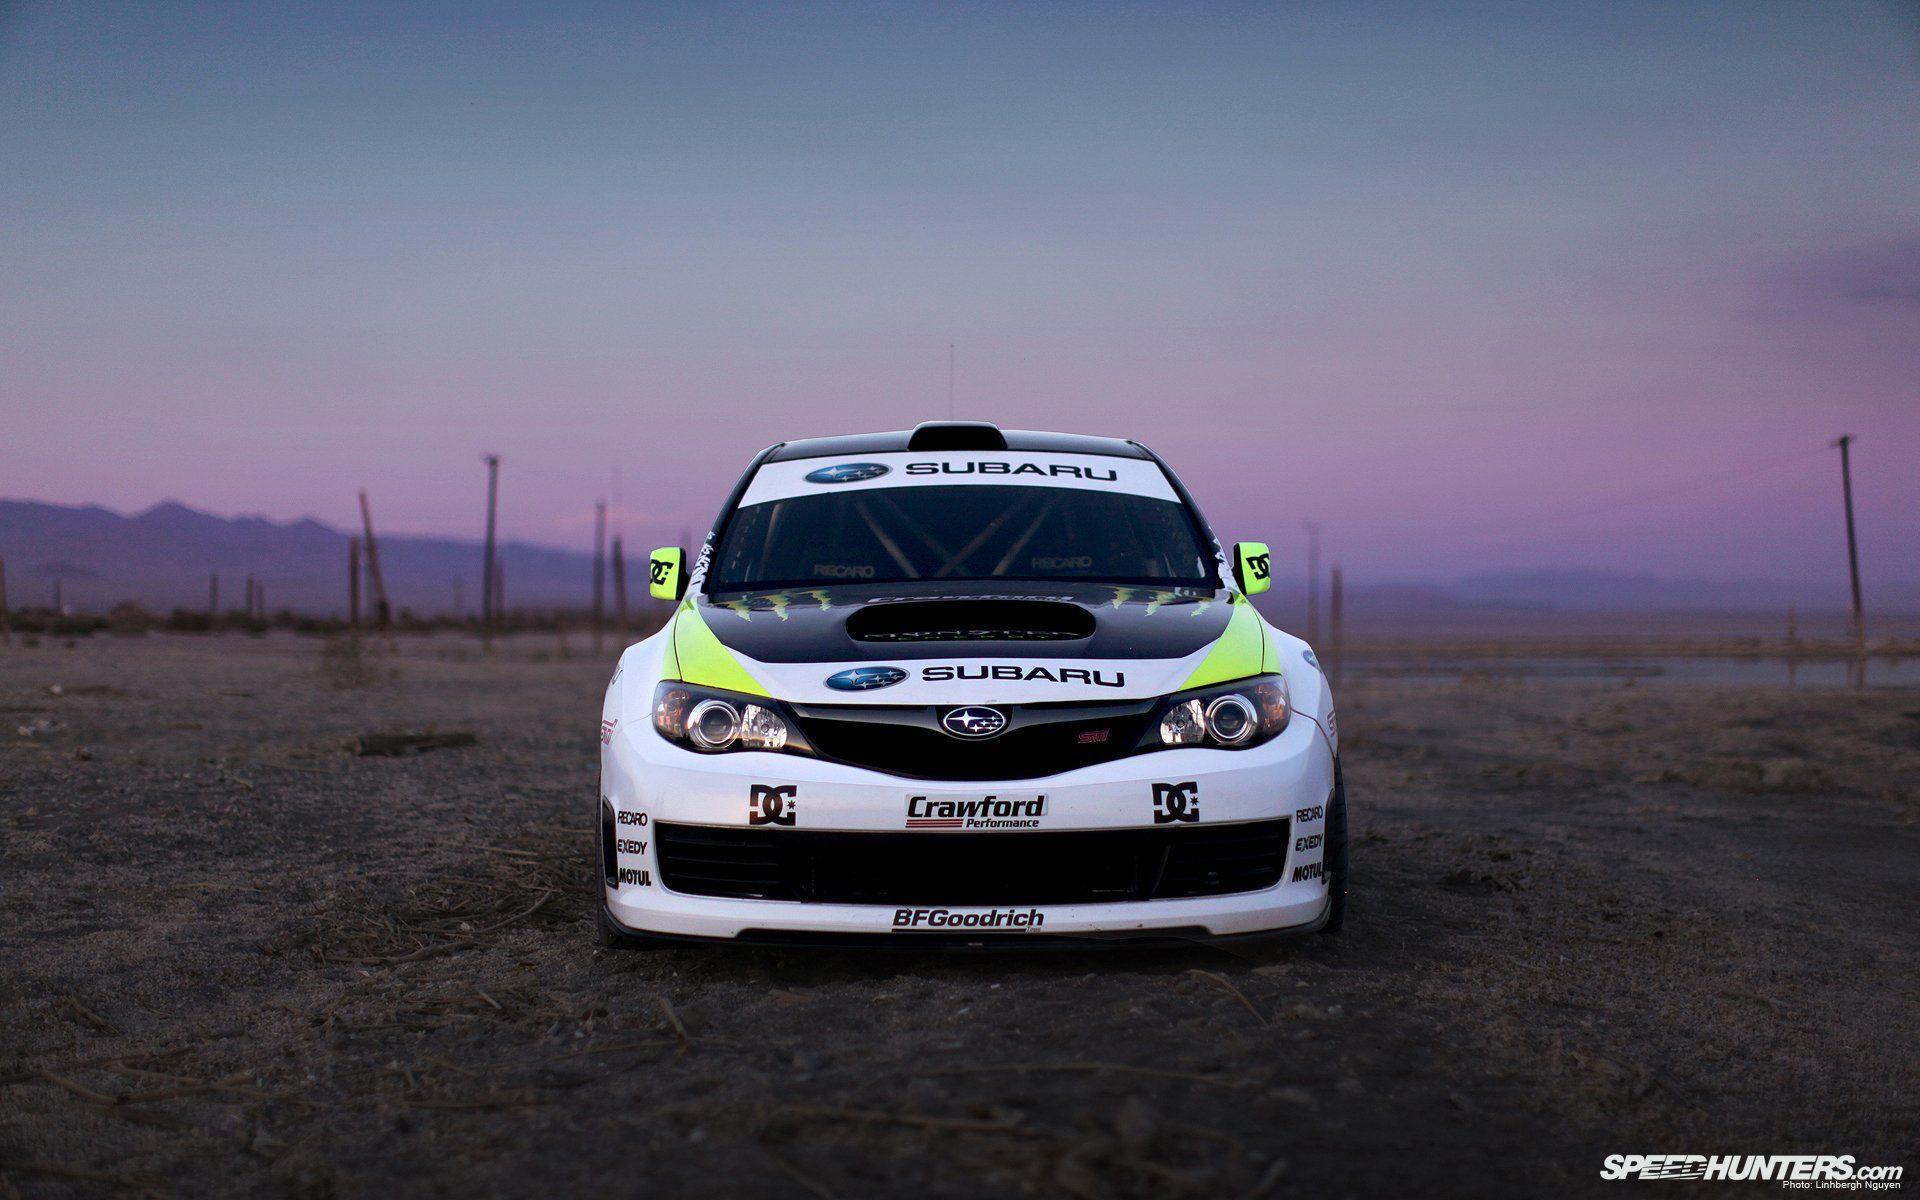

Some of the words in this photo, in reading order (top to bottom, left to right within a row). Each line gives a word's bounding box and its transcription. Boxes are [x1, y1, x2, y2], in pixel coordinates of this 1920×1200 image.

[905, 461, 1117, 482] SUBARU
[814, 564, 875, 578] RECARO
[1032, 556, 1093, 569] RECARO
[922, 665, 1125, 688] SUBARU
[907, 795, 1045, 817] Crawford
[1296, 805, 1323, 823] RECARO
[617, 810, 648, 826] RECARO
[966, 818, 1040, 828] Performance
[617, 839, 647, 855] EXEDY
[1295, 833, 1323, 852] EXEDY
[619, 867, 652, 886] MOTUL
[1292, 861, 1323, 883] MOTUL
[893, 909, 1045, 927] BFGoodrich
